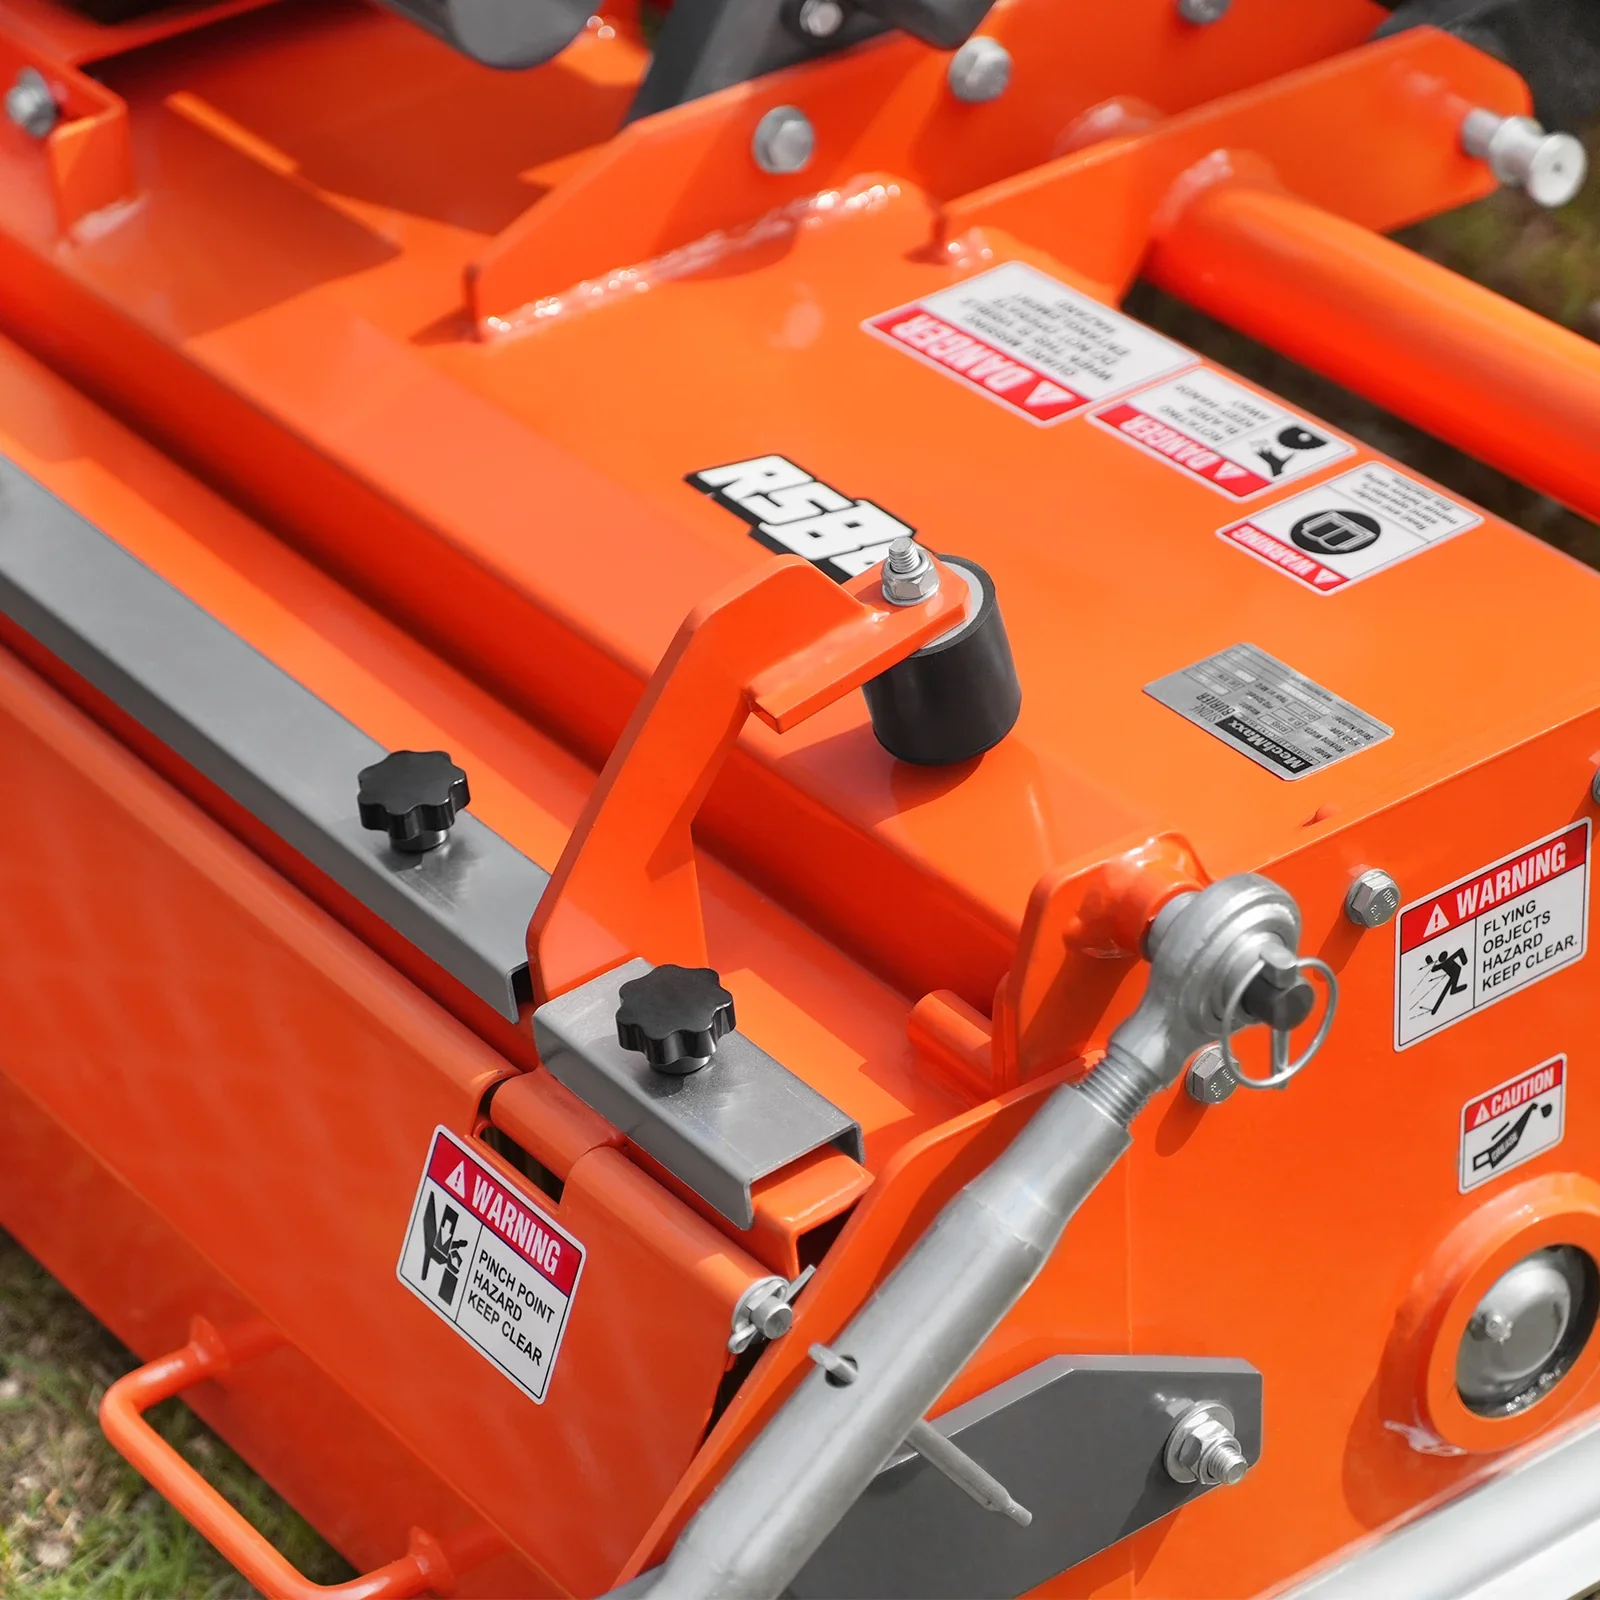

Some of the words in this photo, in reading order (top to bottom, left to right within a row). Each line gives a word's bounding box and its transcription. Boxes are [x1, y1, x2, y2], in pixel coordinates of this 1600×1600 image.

[989, 298, 1060, 334] OPERATE
[1009, 292, 1131, 356] ENTANGLEMENT
[1054, 300, 1119, 334] HAZARD
[890, 313, 1037, 392] DANGER
[1059, 335, 1093, 352] NOT
[1089, 351, 1118, 365] DO
[1064, 354, 1115, 380] WHEN
[1157, 404, 1224, 441] ROTATING
[1219, 408, 1254, 427] KEEP
[1229, 398, 1270, 421] AWAY
[1118, 414, 1223, 471] DANGER
[1230, 526, 1318, 576] WARNING
[1189, 704, 1223, 723] STONE
[1196, 693, 1236, 717] BURIER
[1228, 717, 1305, 769] MechMaxx
[1456, 842, 1565, 919] WARNING
[1483, 899, 1536, 936] FLYING
[1483, 910, 1551, 954] OBJECTS
[1482, 933, 1543, 973] HAZARD
[1482, 962, 1521, 992] KEEP
[1525, 934, 1577, 969] CLEAR.
[1491, 1067, 1555, 1117] CAUTION
[471, 1174, 560, 1276] WARNING
[473, 1270, 522, 1322] HAZARD
[479, 1250, 515, 1292] PINCH
[517, 1283, 555, 1324] POINT
[468, 1290, 500, 1325] KEEP
[501, 1321, 542, 1366] CLEAR
